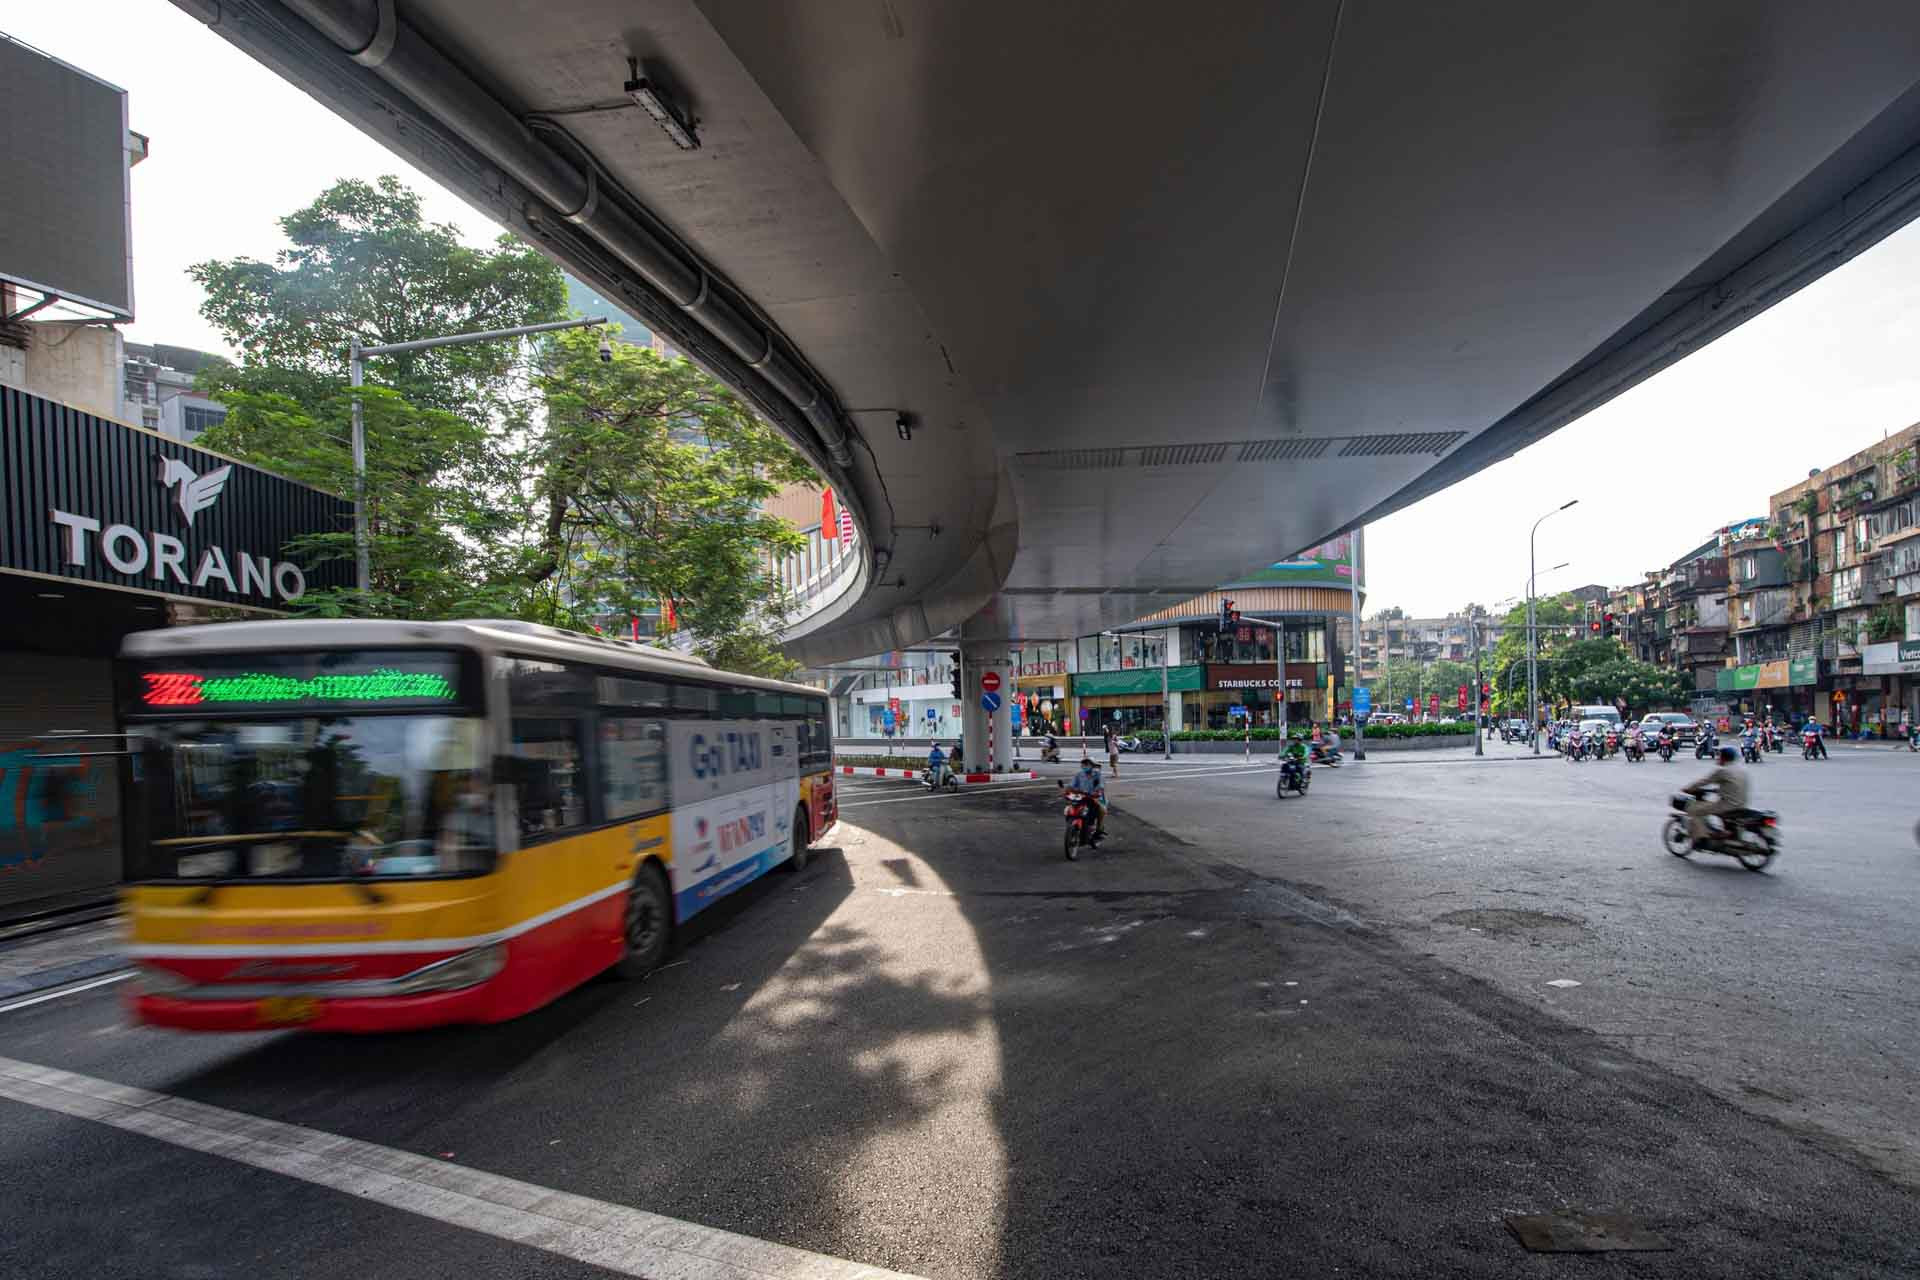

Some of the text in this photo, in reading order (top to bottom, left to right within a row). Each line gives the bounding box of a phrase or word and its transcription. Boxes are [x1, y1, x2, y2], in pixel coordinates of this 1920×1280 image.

[49, 508, 306, 601] TORANO
[1218, 679, 1303, 689] STARBUCKS COFEE
[727, 731, 762, 772] TAXI
